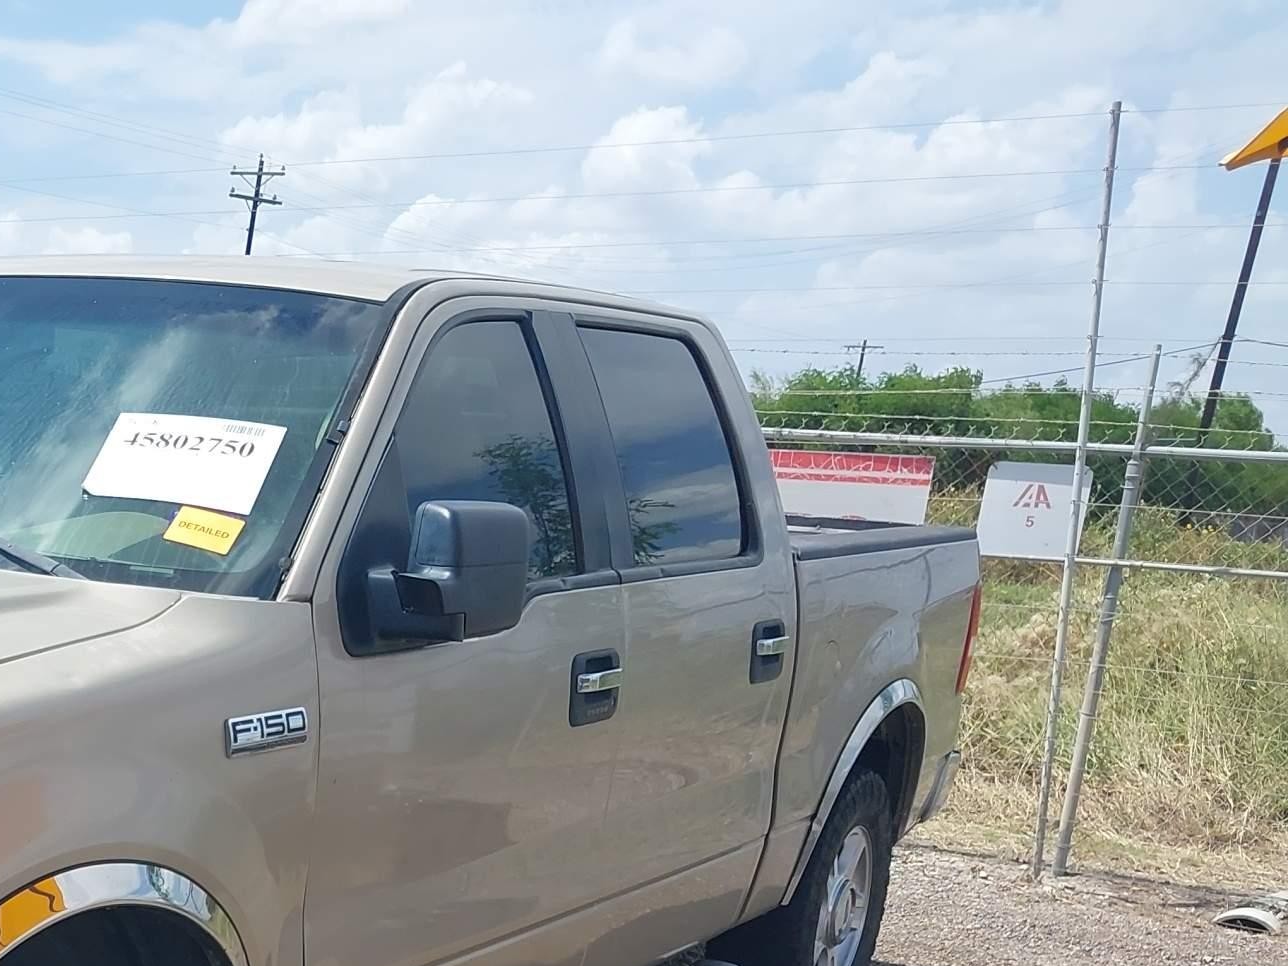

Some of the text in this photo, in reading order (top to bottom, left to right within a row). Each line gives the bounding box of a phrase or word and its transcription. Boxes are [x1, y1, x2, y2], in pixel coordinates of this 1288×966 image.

[123, 431, 256, 458] 45802750
[178, 520, 230, 539] DETAILED
[1025, 515, 1035, 528] 5
